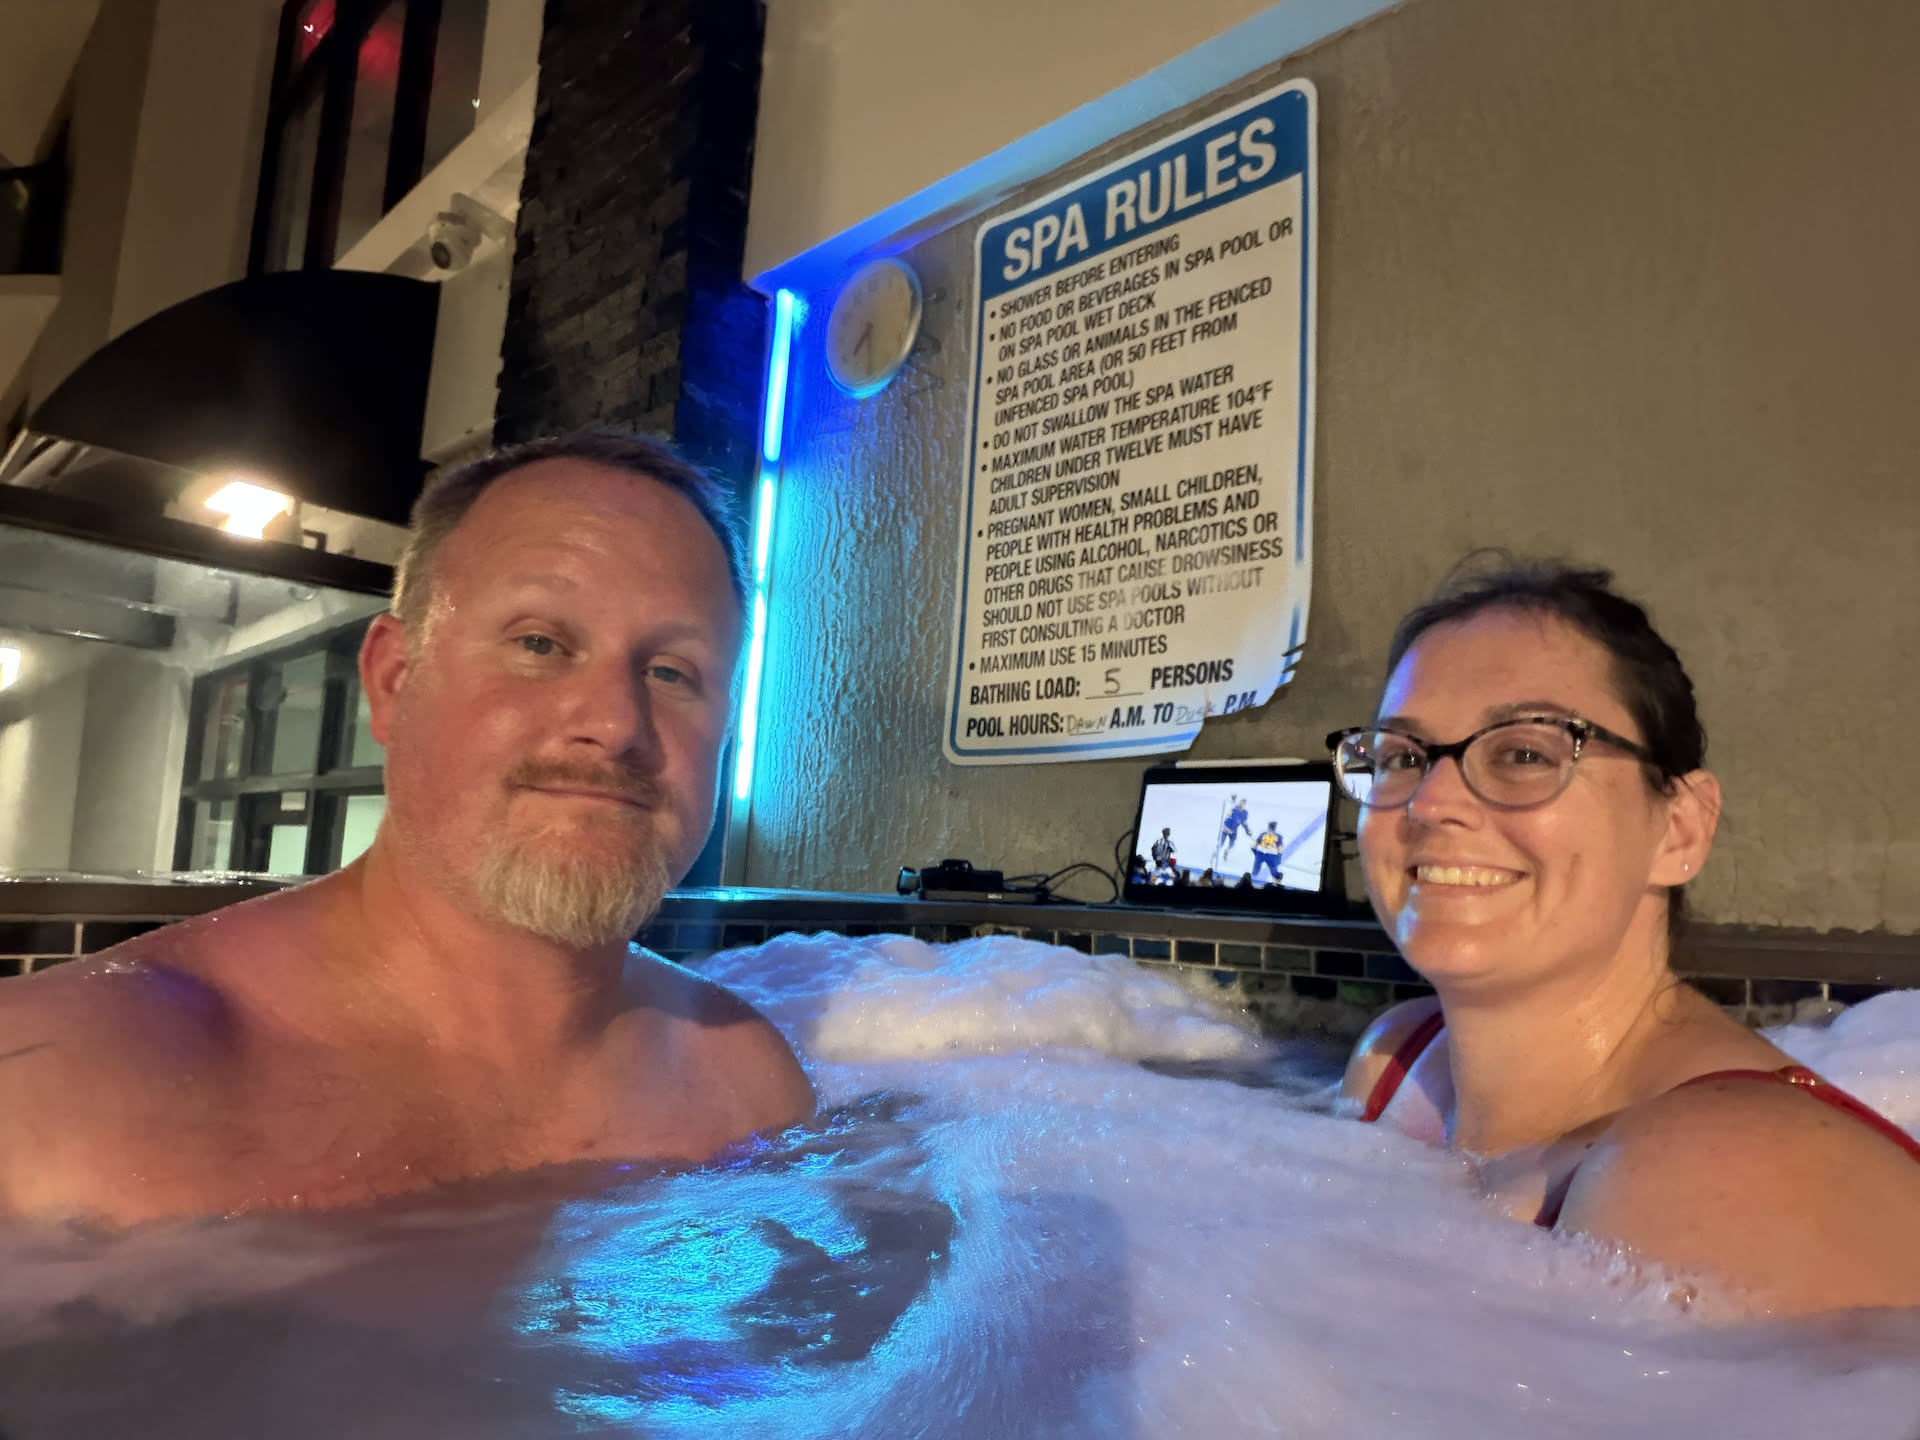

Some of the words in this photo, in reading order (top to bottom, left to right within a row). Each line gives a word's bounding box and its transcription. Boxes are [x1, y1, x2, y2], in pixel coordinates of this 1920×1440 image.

[1002, 202, 1091, 283] SPA
[1104, 117, 1277, 240] RULES
[999, 321, 1016, 341] NO
[1019, 307, 1052, 334] FOOD
[1055, 299, 1074, 320] OR
[1077, 265, 1160, 312] BEVERAGES
[1164, 257, 1180, 280] IN
[1183, 245, 1215, 272] SPA
[1219, 229, 1263, 259] POOL
[1268, 216, 1293, 242] OR
[1000, 284, 1051, 319] SHOWER
[1054, 262, 1105, 297] BEFORE
[1109, 232, 1179, 276] ENTERING
[995, 384, 1019, 406] SPA
[1021, 373, 1055, 397] POOL
[1058, 358, 1095, 386] AREA
[1099, 348, 1123, 374] (OR
[1127, 341, 1146, 363] 50
[1149, 328, 1187, 356] FEET
[1191, 311, 1237, 343] FROM
[996, 364, 1014, 384] NO
[1017, 348, 1058, 378] GLASS
[1061, 341, 1080, 362] OR
[1084, 317, 1149, 355] ANIMALS
[1153, 310, 1169, 332] IN
[1173, 299, 1203, 325] THE
[1208, 276, 1272, 314] FENCED
[998, 342, 1016, 361] ON
[1018, 332, 1042, 355] SPA
[1045, 319, 1080, 345] POOL
[1083, 305, 1114, 331] WET
[1117, 289, 1156, 320] DECK
[991, 439, 1056, 473] MAXIMUM
[1059, 426, 1106, 455] WATER
[1110, 393, 1220, 441] TEMPERATURE
[992, 429, 1010, 450] DO
[1013, 421, 1039, 444] NOT
[1041, 399, 1110, 435] SWALLOW
[1113, 391, 1141, 415] THE
[1145, 382, 1174, 406] SPA
[1178, 363, 1234, 396] WATER
[994, 392, 1059, 426] UNFENCED
[1062, 382, 1089, 406] SPA
[1092, 369, 1134, 397] POOL)
[989, 463, 1051, 494] CHILDREN
[1054, 450, 1101, 478] UNDER
[1104, 433, 1163, 465] TWELVE
[1167, 420, 1213, 450] MUST
[1217, 408, 1262, 437] HAVE
[985, 535, 1033, 561] PEOPLE
[1036, 528, 1070, 551] WITH
[1074, 515, 1129, 544] HEALTH
[1132, 497, 1218, 532] PROBLEMS
[1222, 484, 1259, 514] AND
[986, 508, 1054, 540] PREGNANT
[1058, 496, 1115, 524] WOMEN,
[1119, 483, 1171, 511] SMALL
[1176, 463, 1262, 499] CHILDREN,
[988, 490, 1028, 516] ADULT
[1030, 468, 1120, 506] SUPERVISION
[983, 581, 1024, 605] OTHER
[1028, 573, 1073, 598] DRUGS
[1077, 566, 1114, 589] THAT
[1117, 557, 1166, 582] CAUSE
[1172, 536, 1283, 574] DROWSINESS
[984, 557, 1032, 583] PEOPLE
[1034, 549, 1075, 574] USING
[1078, 537, 1150, 566] ALCOHOL,
[1155, 516, 1248, 552] NARCOTICS
[1252, 511, 1278, 534] OR
[981, 627, 1017, 649] FIRST
[1019, 616, 1103, 644] CONSULTING
[1107, 615, 1117, 632] A
[1123, 600, 1185, 631] DOCTOR
[982, 603, 1032, 627] SHOULD
[1035, 597, 1063, 619] NOT
[1066, 591, 1095, 616] USE
[1097, 585, 1128, 611] SPA
[1130, 576, 1182, 606] POOLS
[1186, 562, 1264, 597] WITHOUT
[969, 679, 1031, 705] BATHING
[1035, 675, 1080, 700] LOAD:
[1103, 667, 1120, 694] 5
[1150, 657, 1233, 690] PERSONS
[979, 649, 1045, 674] MAXIMUM
[1049, 645, 1076, 666] USE
[1080, 643, 1096, 662] 15
[1100, 633, 1167, 660] MINUTES
[966, 717, 1006, 737] POOL
[1009, 711, 1064, 735] HOURS:
[1109, 705, 1145, 729] A.M.
[1153, 702, 1175, 725] TO
